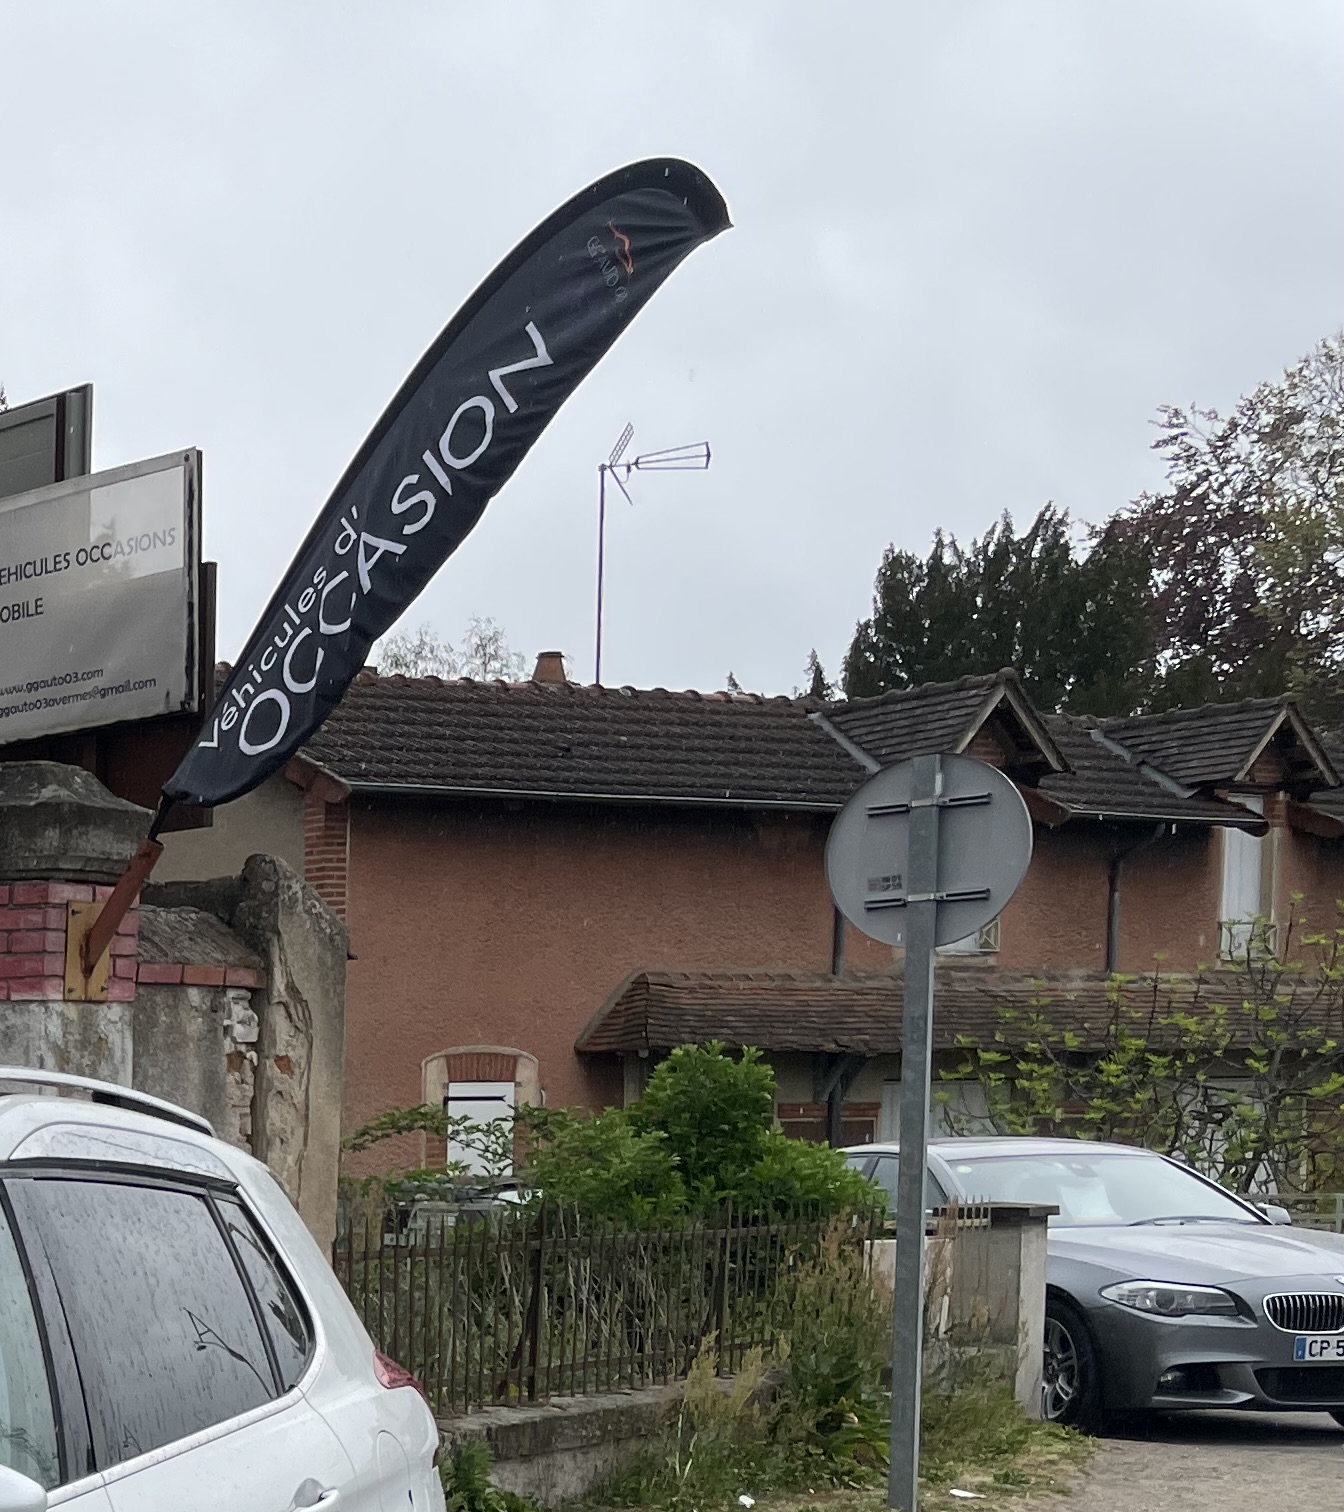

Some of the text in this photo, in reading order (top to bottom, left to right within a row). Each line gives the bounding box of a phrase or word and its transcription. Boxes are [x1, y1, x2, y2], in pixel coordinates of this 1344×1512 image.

[75, 527, 176, 566] OCCASIONS
[238, 321, 554, 755] OCCASION
[198, 566, 327, 748] Véhicules
